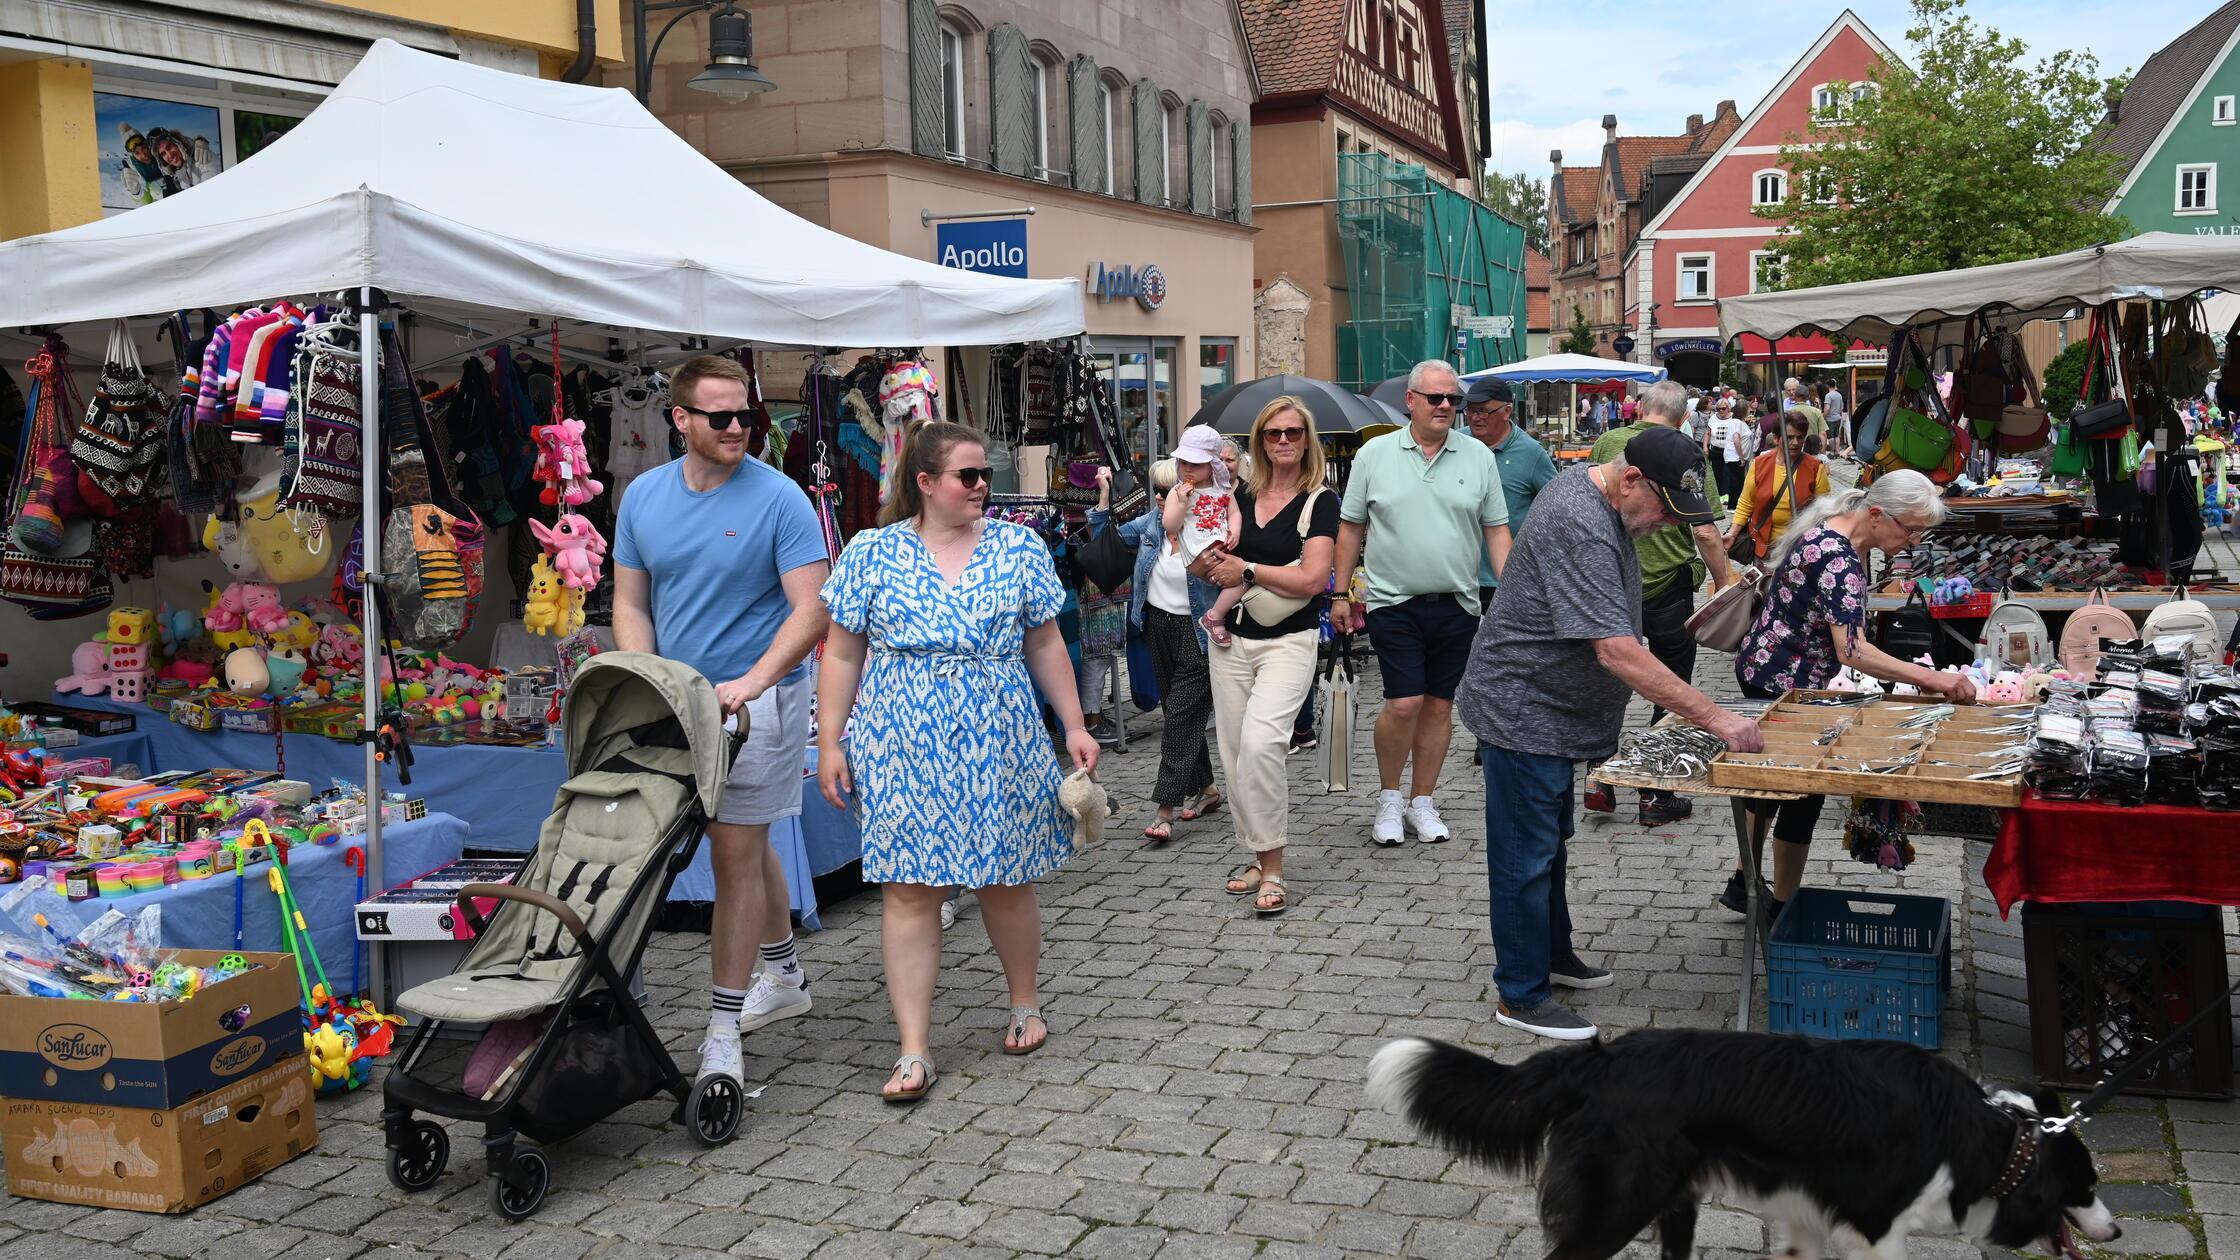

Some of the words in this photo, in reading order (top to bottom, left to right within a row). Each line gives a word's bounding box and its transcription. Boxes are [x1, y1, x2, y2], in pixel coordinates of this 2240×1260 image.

[942, 241, 1024, 271] Apollo
[1097, 261, 1142, 304] Apollo
[1671, 343, 1714, 352] LÖWENKELLER
[44, 1032, 107, 1061] SanLucar
[215, 1041, 263, 1071] SanLucar
[118, 1079, 133, 1087] Taste
[182, 1100, 213, 1120] FIRST
[215, 1080, 260, 1106] QUALITY
[262, 1057, 307, 1086] BANANAS
[20, 1178, 52, 1191] FIRST
[53, 1183, 103, 1199] QUALITY
[106, 1189, 164, 1206] BANANAS
